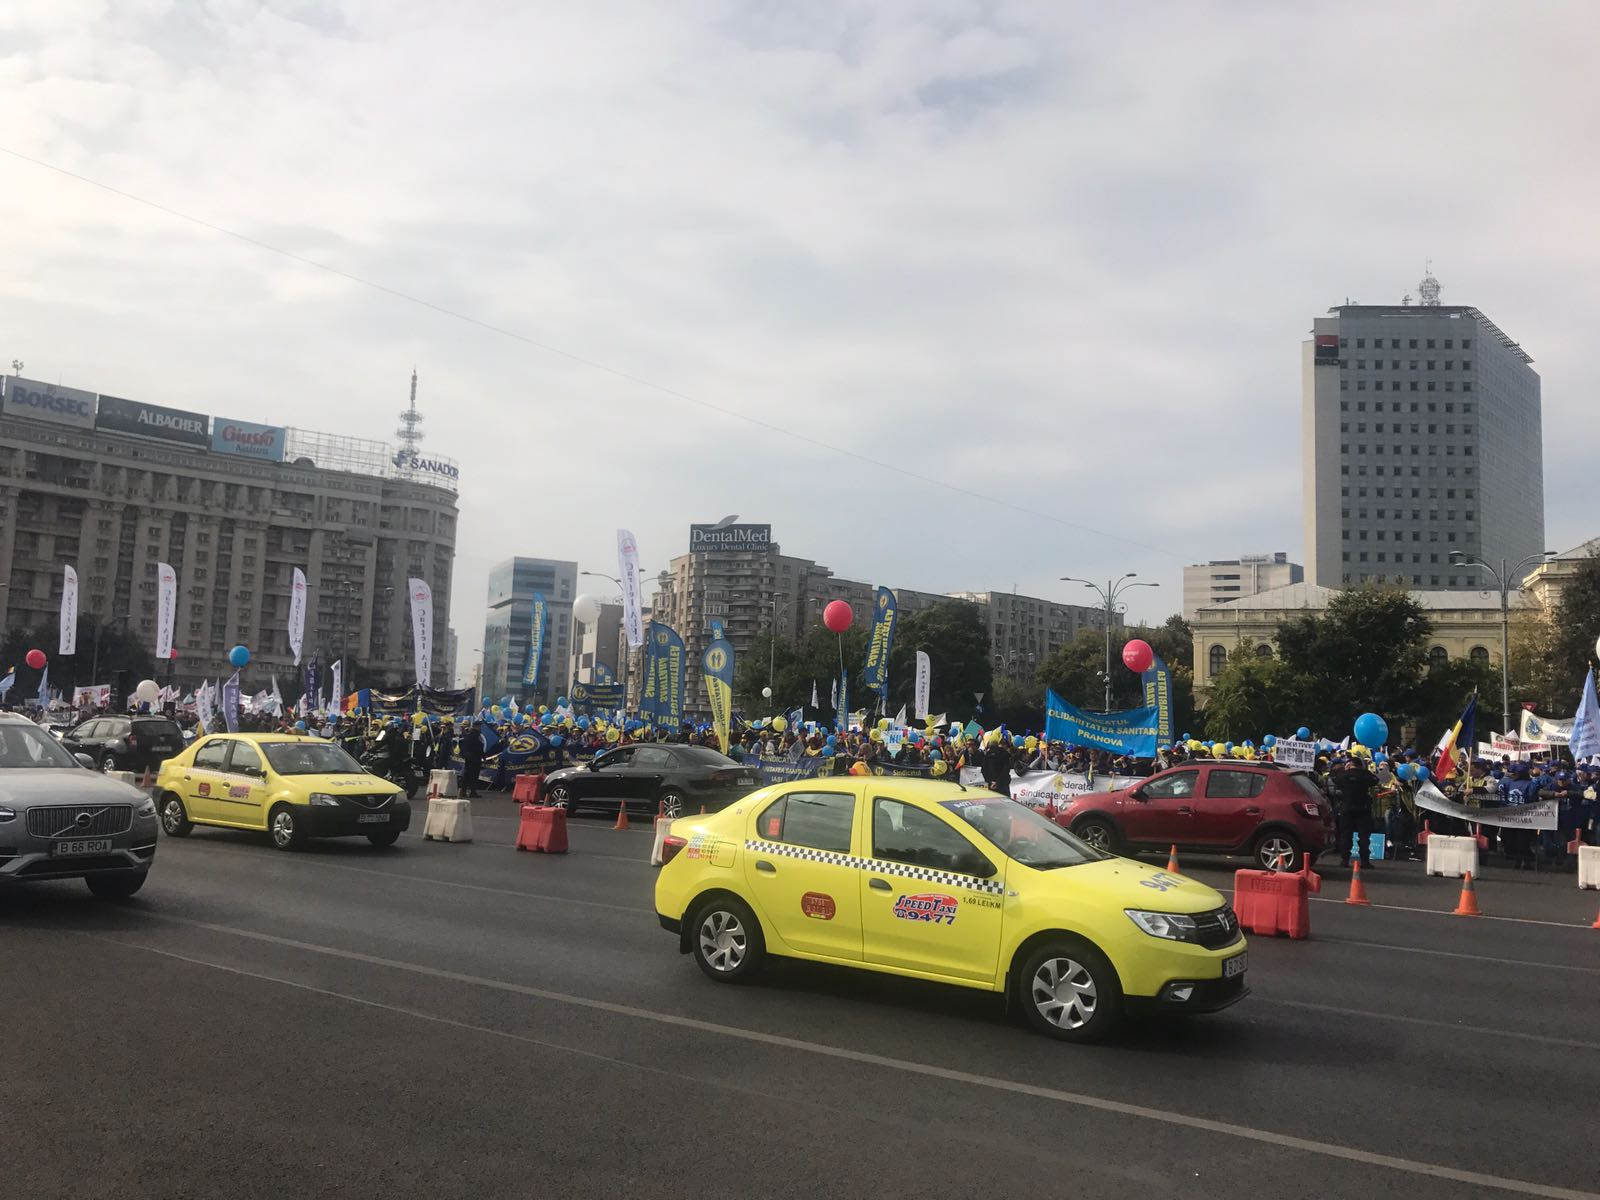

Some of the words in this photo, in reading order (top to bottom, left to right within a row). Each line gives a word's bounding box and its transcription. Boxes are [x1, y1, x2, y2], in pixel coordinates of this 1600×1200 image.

[12, 385, 89, 416] BORSEC
[137, 408, 204, 435] ALBACHER
[411, 458, 459, 480] SANADOR
[692, 529, 769, 542] DentalMed
[721, 543, 745, 551] Dental
[747, 543, 769, 551] Clinic
[1048, 709, 1115, 735] OLIDARITATEA
[1117, 727, 1158, 736] SANITAR
[1077, 729, 1124, 747] PRAHOVA
[1020, 788, 1069, 801] Sindicatelor
[60, 843, 69, 853] B
[71, 842, 84, 852] 66
[87, 841, 107, 851] ROA
[907, 911, 956, 925] 9477
